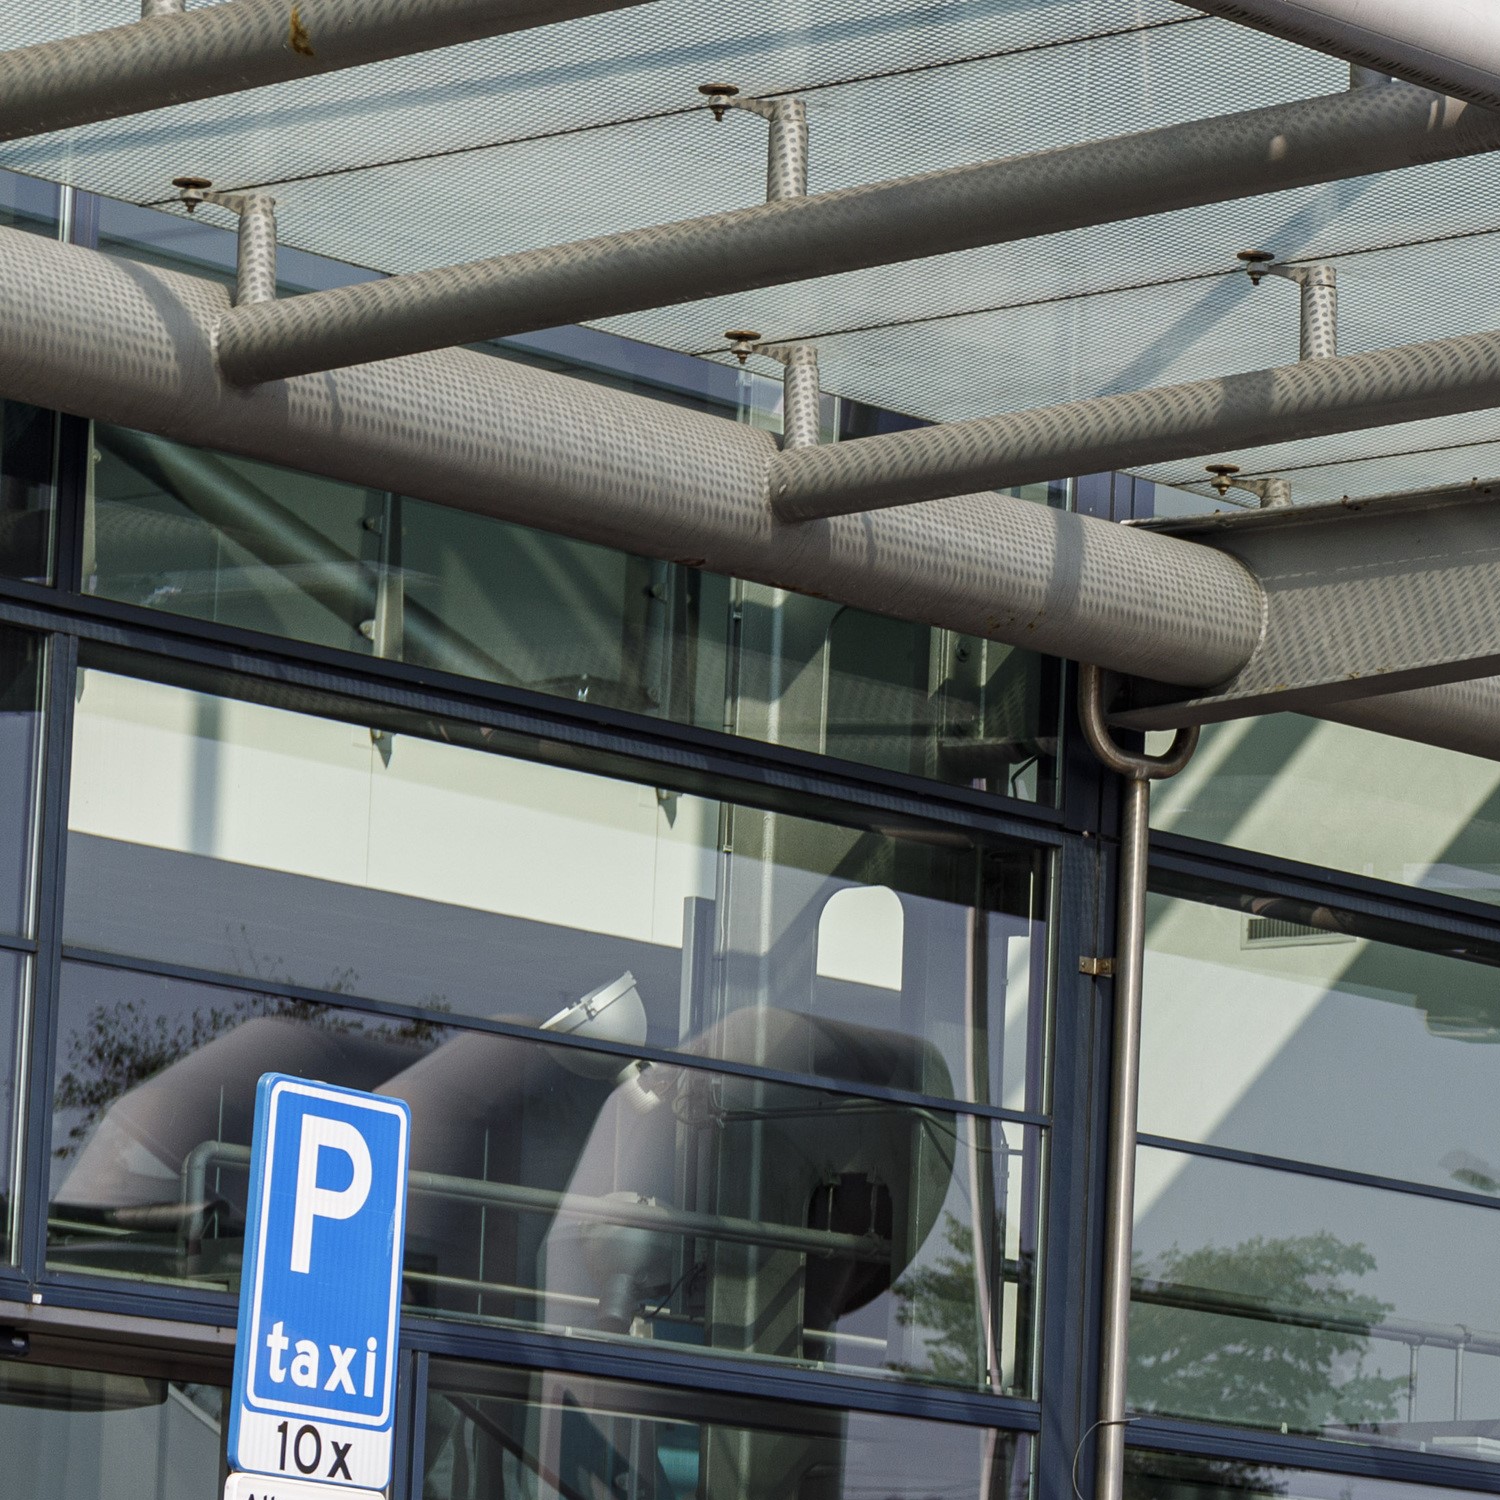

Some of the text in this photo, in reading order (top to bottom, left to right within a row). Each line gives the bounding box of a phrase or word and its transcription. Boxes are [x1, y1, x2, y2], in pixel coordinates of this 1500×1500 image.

[289, 1112, 373, 1275] P
[265, 1320, 378, 1398] taxi
[277, 1420, 353, 1482] 10x
